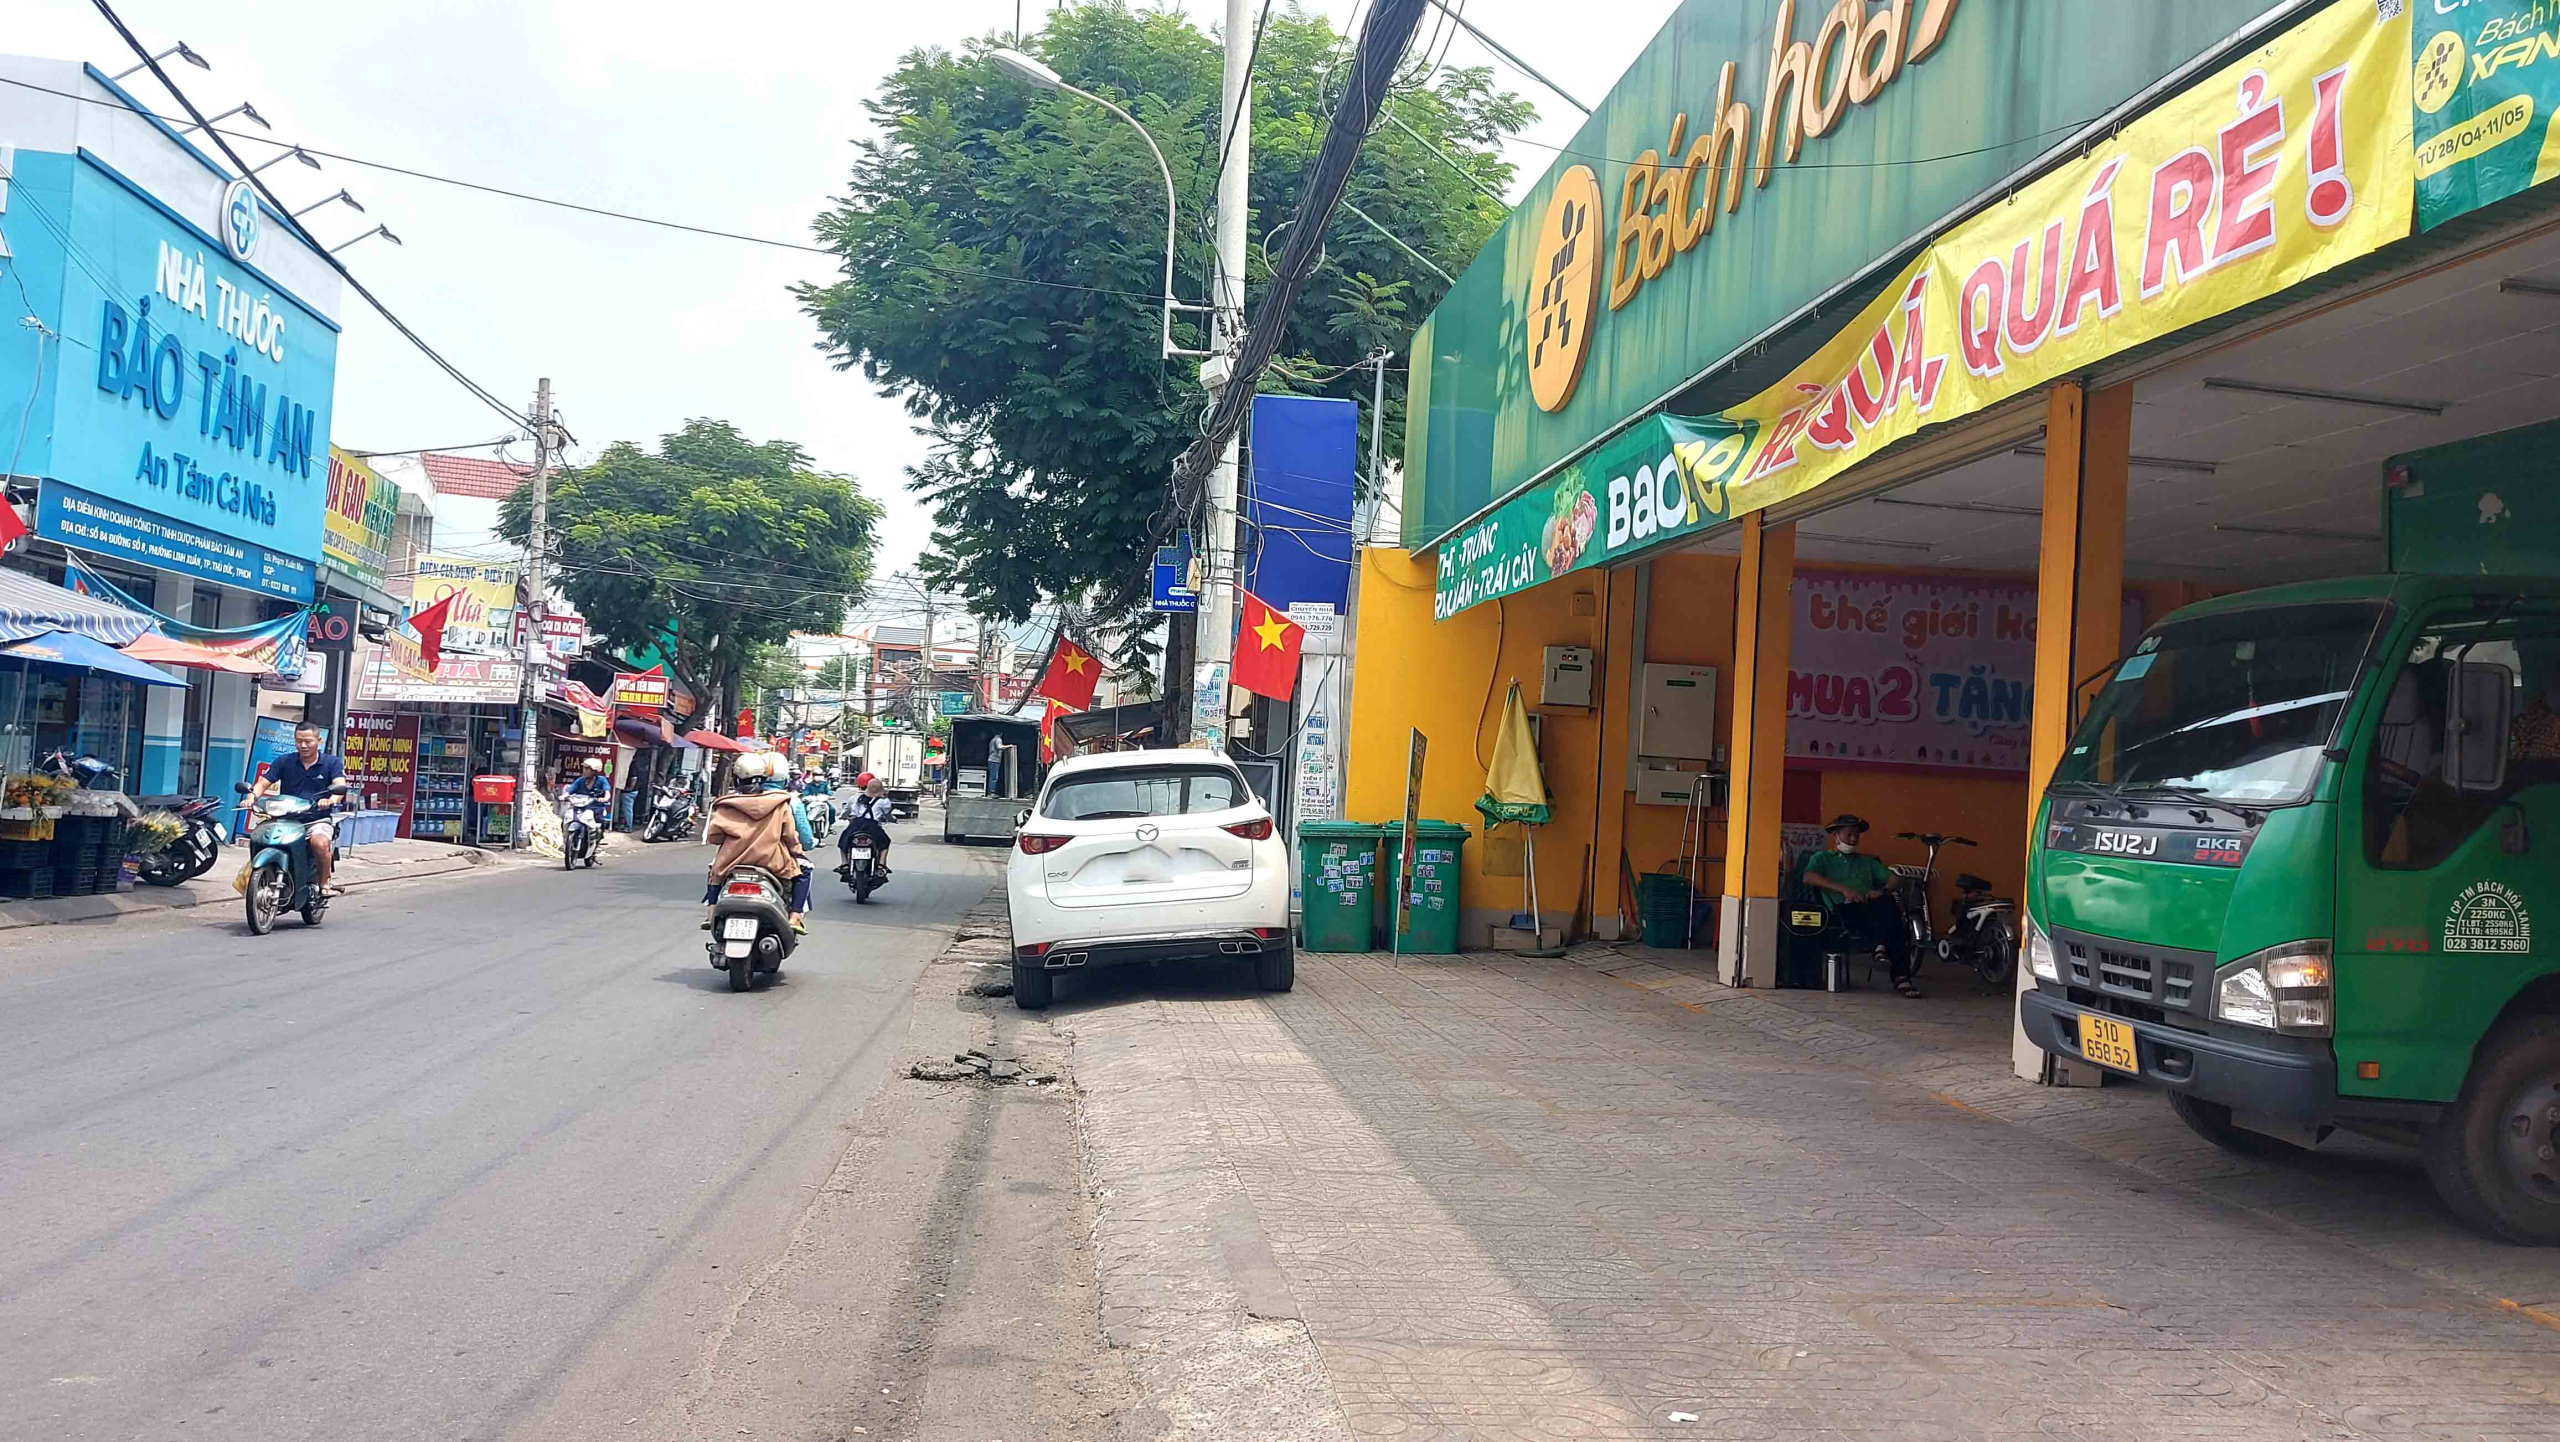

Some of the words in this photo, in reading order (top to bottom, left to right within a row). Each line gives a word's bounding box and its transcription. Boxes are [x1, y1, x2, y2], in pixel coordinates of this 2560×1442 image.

[2475, 0, 2544, 46] Bách
[2418, 146, 2436, 168] TỪ
[2439, 105, 2524, 158] 28/04-11/05
[1608, 60, 1751, 312] Bách
[1959, 155, 2127, 379] QUÁ
[2140, 69, 2286, 299] RẺ
[156, 238, 207, 321] NHÀ
[216, 275, 285, 363] THUỐC
[98, 295, 184, 420] BẢO
[199, 346, 267, 457] TÂM
[267, 394, 315, 478] AN
[136, 441, 169, 489] An
[217, 472, 240, 514] Cả
[243, 480, 276, 526] Nhà
[61, 519, 74, 535] ĐỊA
[89, 525, 99, 540] SỐ
[108, 532, 131, 549] ĐƯỜNG
[132, 536, 141, 550] SỐ
[148, 544, 173, 560] PHƯỜNG
[172, 552, 186, 562] LINH
[62, 496, 76, 513] ĐỊA
[94, 507, 110, 523] KINH
[109, 511, 133, 528] DOANH
[133, 516, 151, 532] CÔNG
[152, 523, 161, 536] TY
[161, 526, 177, 541] TNHH
[235, 549, 244, 559] AN
[1512, 542, 1538, 588] CÂY
[1155, 598, 1169, 606] NHÀ
[1169, 598, 1189, 607] THUỐC
[1809, 592, 1893, 633] thế
[1902, 599, 1980, 649] giới
[1787, 669, 1873, 720] MUA
[1929, 664, 2036, 736] TẶN
[2193, 850, 2240, 863] 270
[2196, 837, 2241, 850] QKR
[2459, 886, 2475, 902] TM
[2477, 879, 2504, 894] BÁCH
[2450, 900, 2462, 914] CP
[2470, 910, 2506, 919] 2250KG
[2481, 898, 2496, 907] 3N
[2444, 916, 2457, 935] CTY
[2461, 919, 2484, 927] TLBT:
[2485, 919, 2514, 928] 2550KG
[2461, 927, 2483, 935] TLTB:
[2485, 927, 2514, 935] 4995KG
[2517, 909, 2531, 937] XANH
[2446, 938, 2467, 950] 028
[2470, 938, 2497, 950] 3812
[2500, 938, 2527, 951] 5960
[2094, 1019, 2119, 1042] 51D
[2086, 1038, 2132, 1069] 658.52
